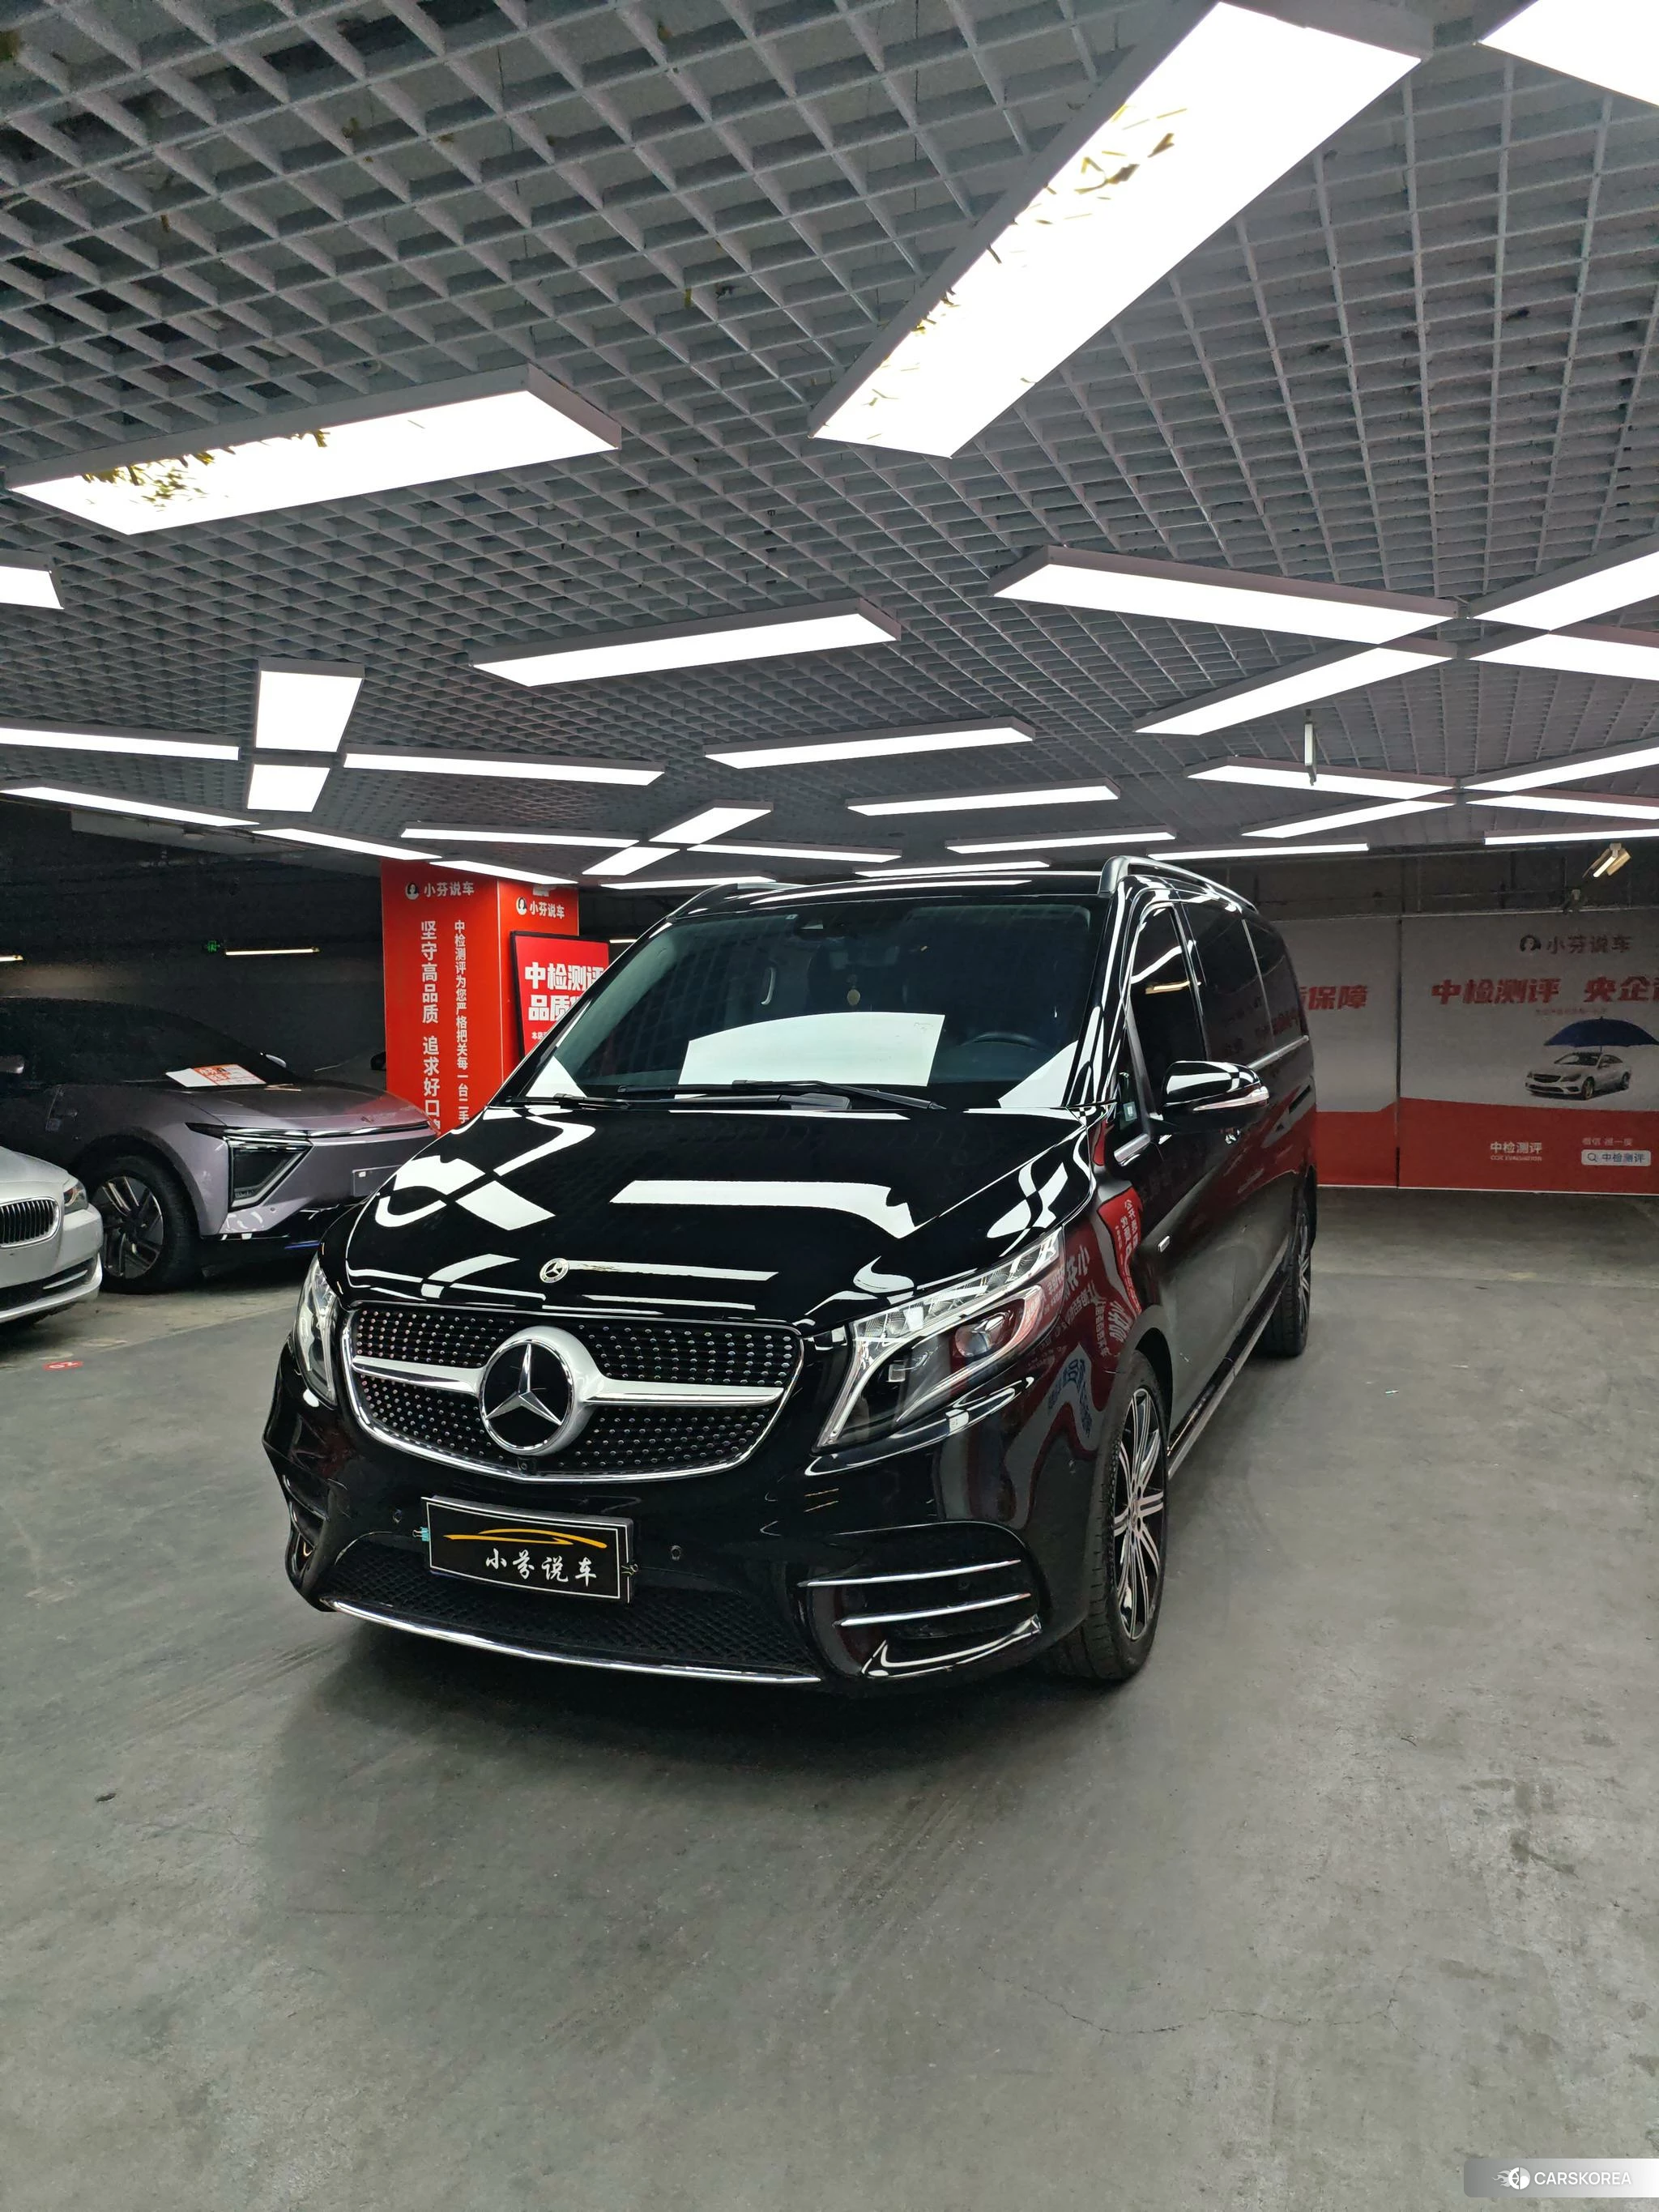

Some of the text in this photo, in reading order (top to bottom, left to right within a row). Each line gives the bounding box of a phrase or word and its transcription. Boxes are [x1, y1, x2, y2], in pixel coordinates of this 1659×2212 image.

[424, 881, 475, 897] 小芬说车
[530, 901, 565, 919] 小芬说车
[1546, 935, 1633, 954] 小芬说车
[420, 920, 438, 1024] 坚守高品质
[524, 961, 604, 991] 中检测评
[1430, 976, 1659, 1005] 中检测评 央企
[1491, 1141, 1542, 1154] 中检测评
[1601, 1153, 1644, 1162] 中检测评
[485, 1548, 597, 1587] 小芬说车
